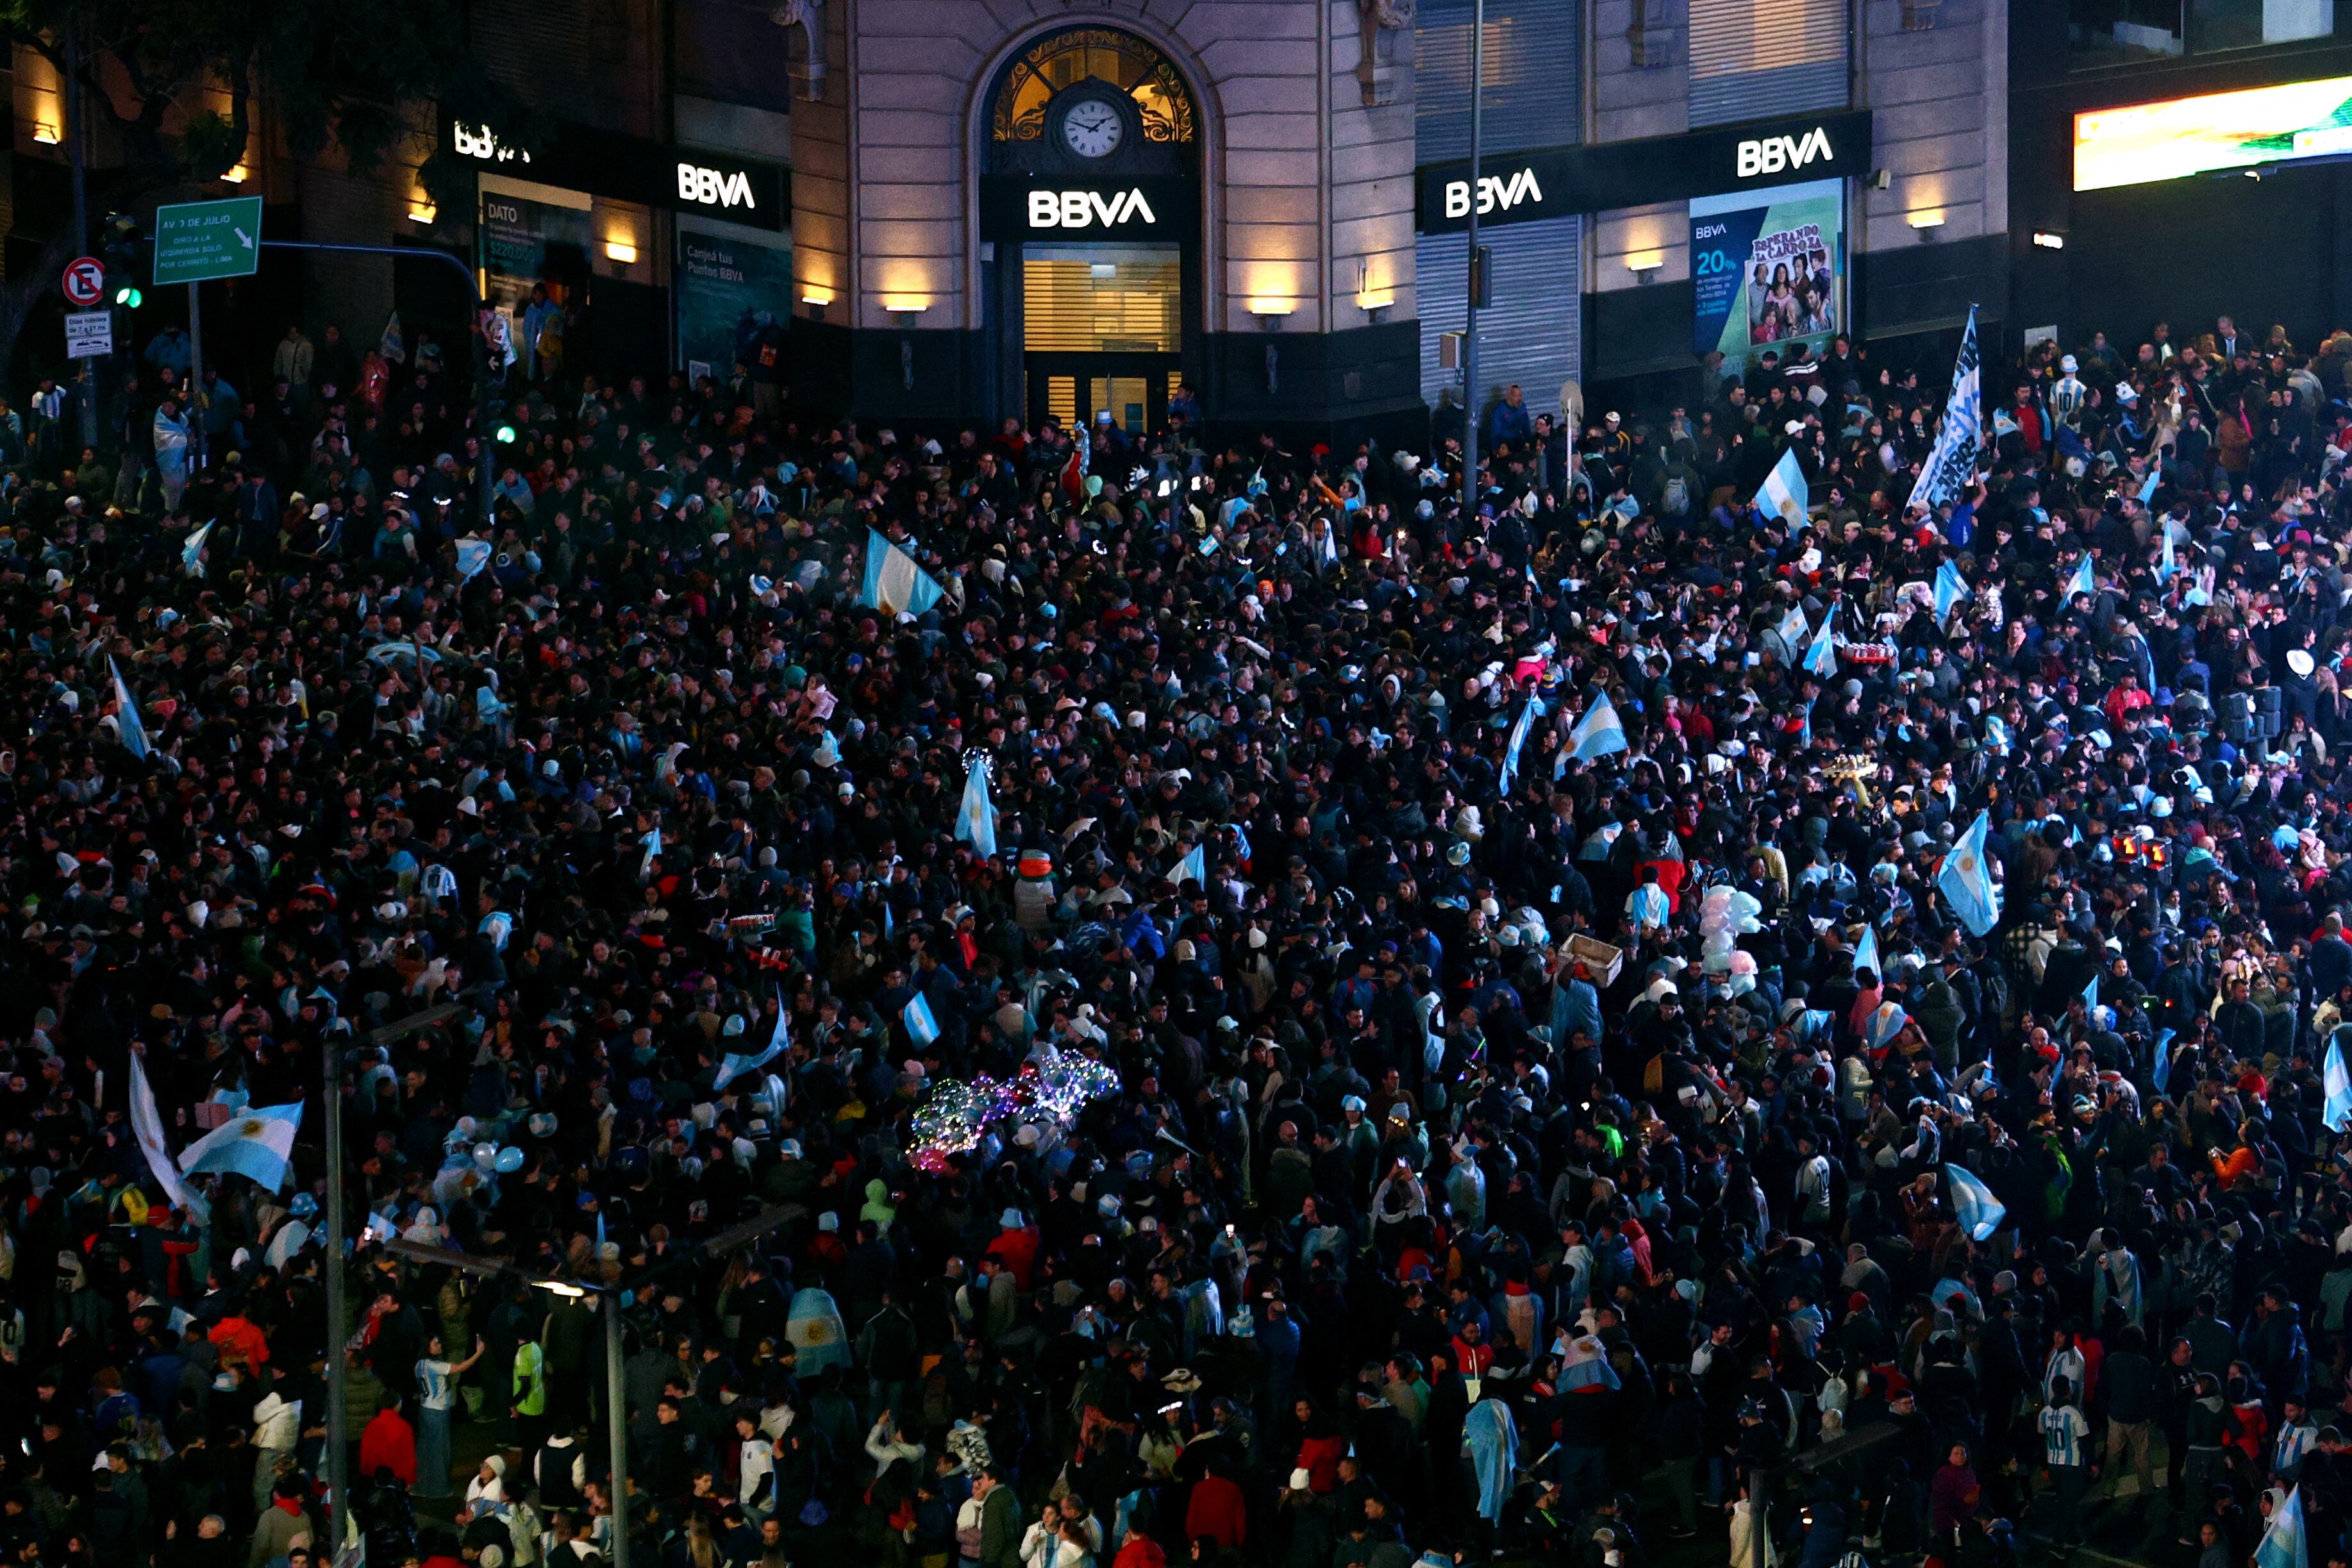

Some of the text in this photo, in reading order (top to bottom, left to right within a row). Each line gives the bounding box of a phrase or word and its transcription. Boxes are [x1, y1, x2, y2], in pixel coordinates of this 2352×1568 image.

[1737, 127, 1833, 178] BBVA
[677, 162, 755, 210] BBVA
[1444, 167, 1543, 219] BBVA
[488, 203, 517, 223] DATO
[1028, 188, 1156, 228] BBVA
[203, 215, 230, 225] JULIO
[1696, 223, 1726, 240] BBVA
[1754, 224, 1819, 252] ESPERANDO
[1756, 237, 1822, 262] LA CARROZA
[161, 247, 199, 256] IZQUIERDA
[687, 245, 733, 265] Canjeá tus
[1697, 250, 1736, 276] 20%
[687, 262, 744, 283] Puntos BBVA
[2058, 392, 2072, 412] 10
[428, 874, 440, 888] 10
[2046, 1426, 2066, 1451] 10
